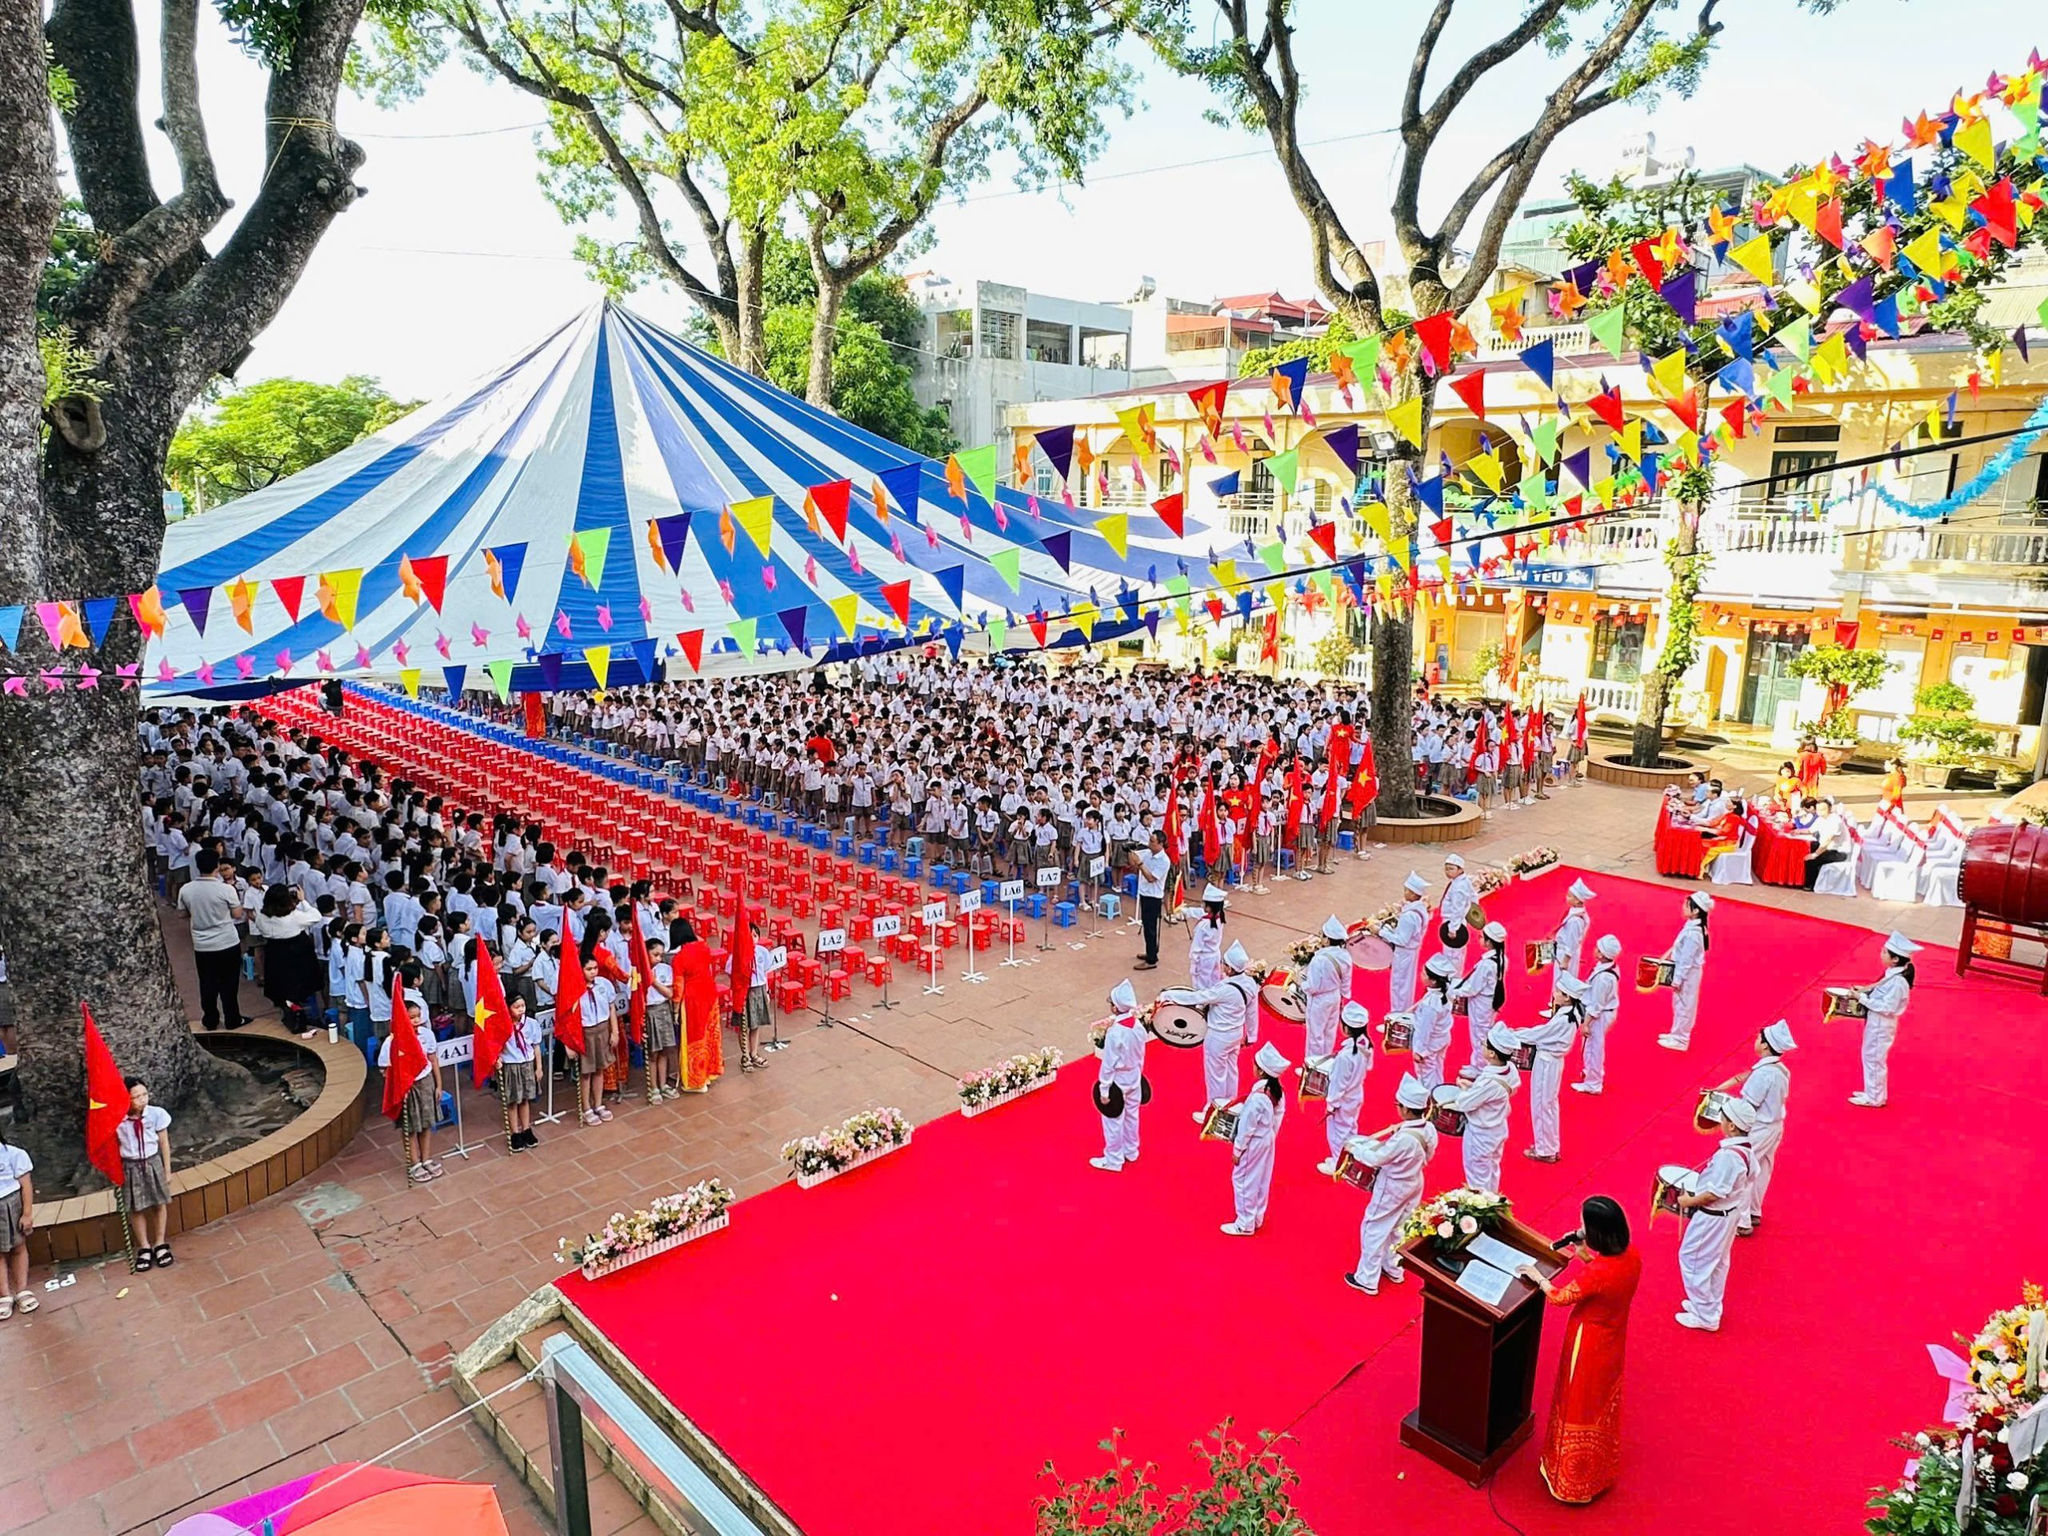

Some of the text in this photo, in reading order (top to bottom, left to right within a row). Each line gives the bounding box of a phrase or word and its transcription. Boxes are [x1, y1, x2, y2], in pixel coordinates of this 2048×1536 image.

[1040, 872, 1058, 882] 1A7
[1004, 885, 1021, 897] 1A6
[964, 896, 979, 908] 1A5
[926, 908, 943, 920] 1A4
[877, 920, 897, 932] 1A3
[822, 934, 842, 946] 1A2
[771, 952, 783, 966] A1
[440, 1044, 471, 1060] 4A1
